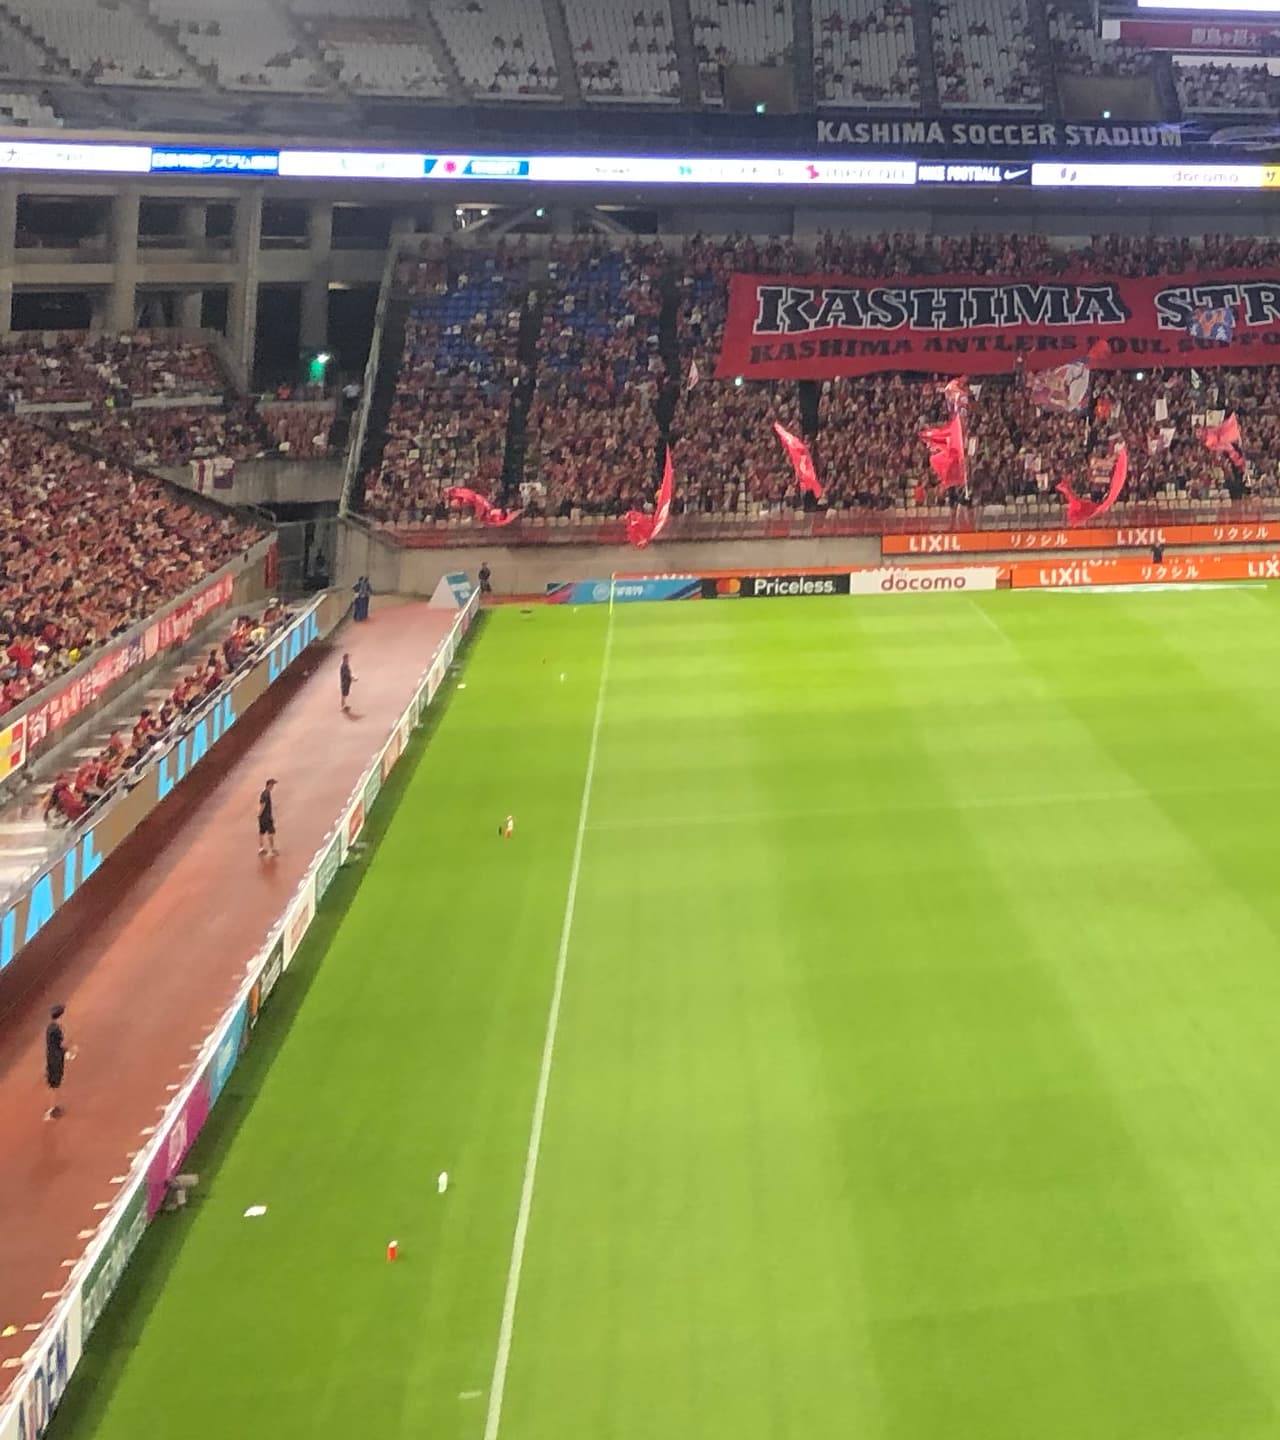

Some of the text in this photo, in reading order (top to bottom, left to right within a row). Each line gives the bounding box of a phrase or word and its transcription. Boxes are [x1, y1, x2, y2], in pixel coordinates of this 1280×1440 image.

[816, 120, 1182, 148] KASHIMA SOCCER STADIUM
[918, 165, 1001, 182] NIKE FOOTBALL
[752, 283, 1126, 335] KASHIMA
[751, 337, 913, 364] KASHIMA
[923, 333, 1078, 354] ANTLERS
[1010, 533, 1069, 548] リクシル
[1116, 528, 1167, 546] LIXIL
[1212, 525, 1269, 541] リクシル
[908, 535, 961, 553] LIXIL
[1039, 566, 1092, 586] LIXIL
[1140, 563, 1200, 581] リクシル
[881, 572, 967, 591] docomo
